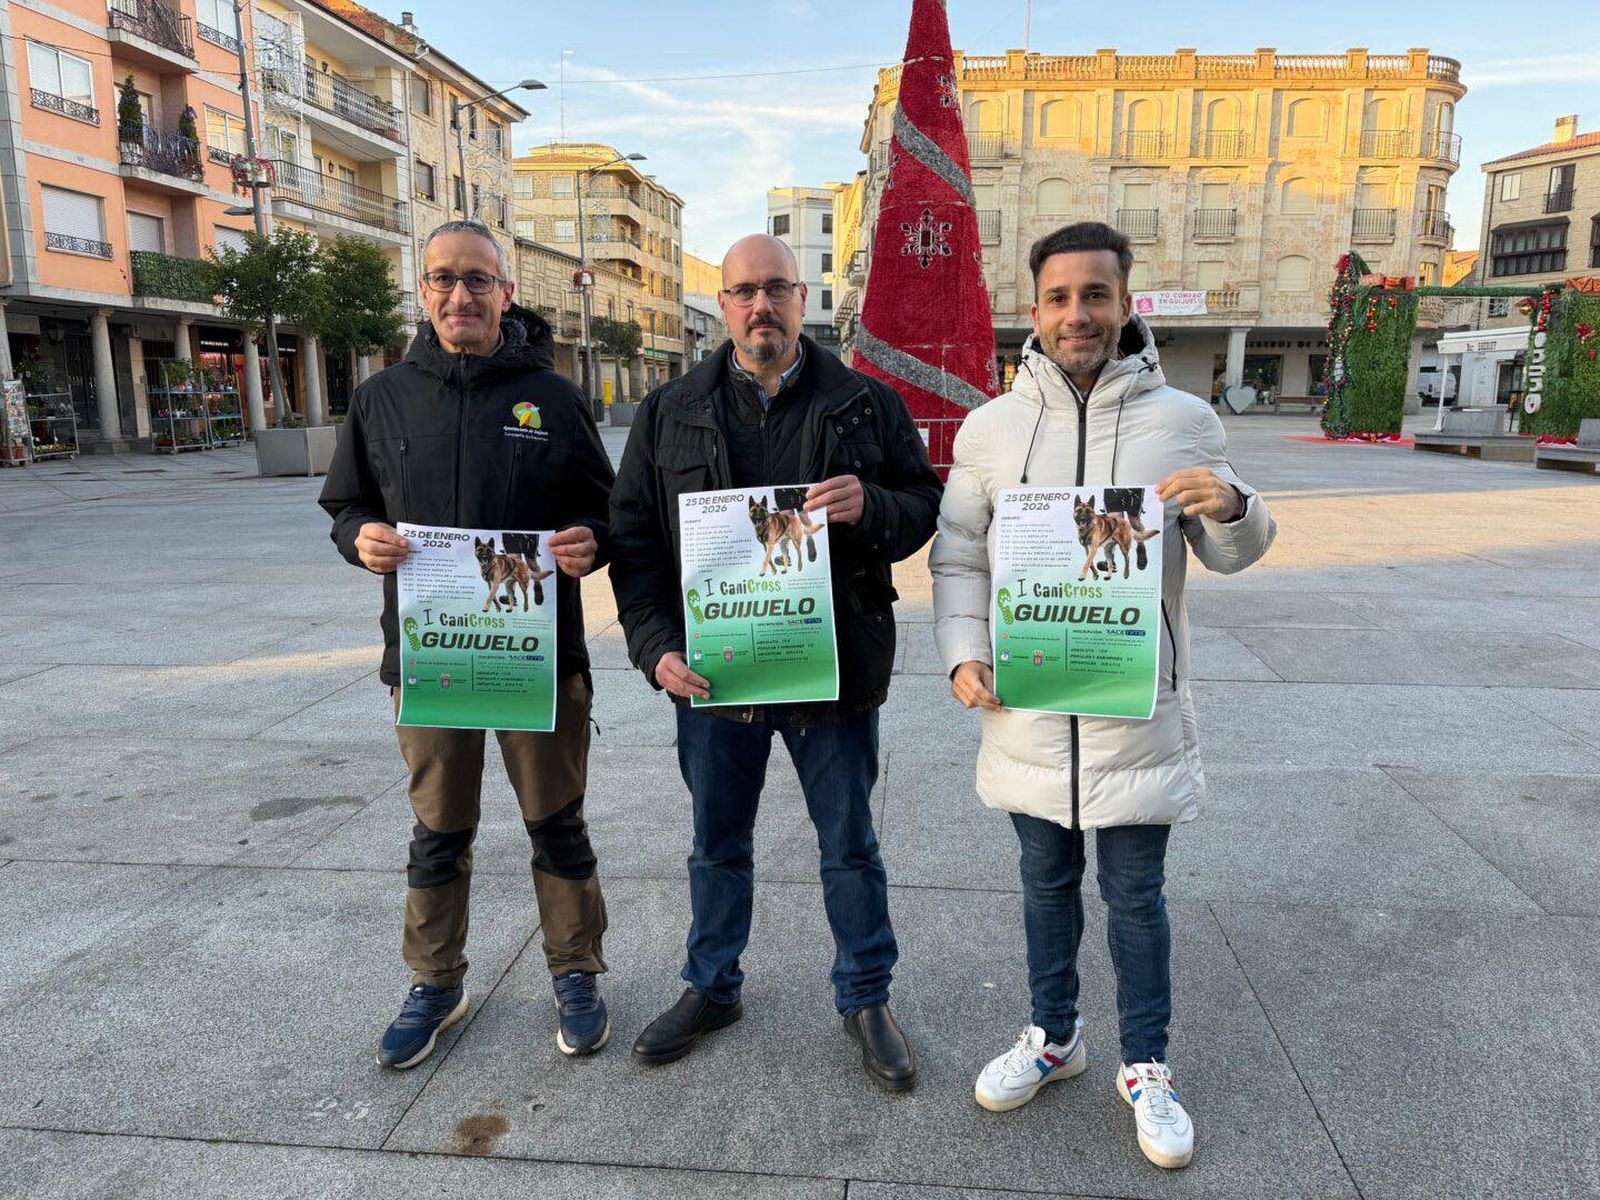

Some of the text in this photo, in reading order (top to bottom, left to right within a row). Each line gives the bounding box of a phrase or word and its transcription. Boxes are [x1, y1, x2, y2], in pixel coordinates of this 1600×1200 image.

[685, 494, 745, 506] 25 DE ENERO
[1005, 492, 1071, 502] 25 DE ENERO
[702, 504, 728, 514] 2026
[1022, 502, 1051, 511] 2026
[403, 529, 470, 541] 25 DE ENERO
[422, 540, 452, 549] 2026
[704, 578, 715, 597] I
[720, 579, 781, 596] CaniCross
[1017, 578, 1027, 597] I
[1033, 582, 1103, 599] CaniCross
[704, 597, 816, 620] GUIJUELO
[1014, 603, 1140, 626] GUIJUELO
[423, 608, 434, 626] I
[440, 613, 505, 629] CaniCross
[421, 631, 539, 652] GUIJUELO
